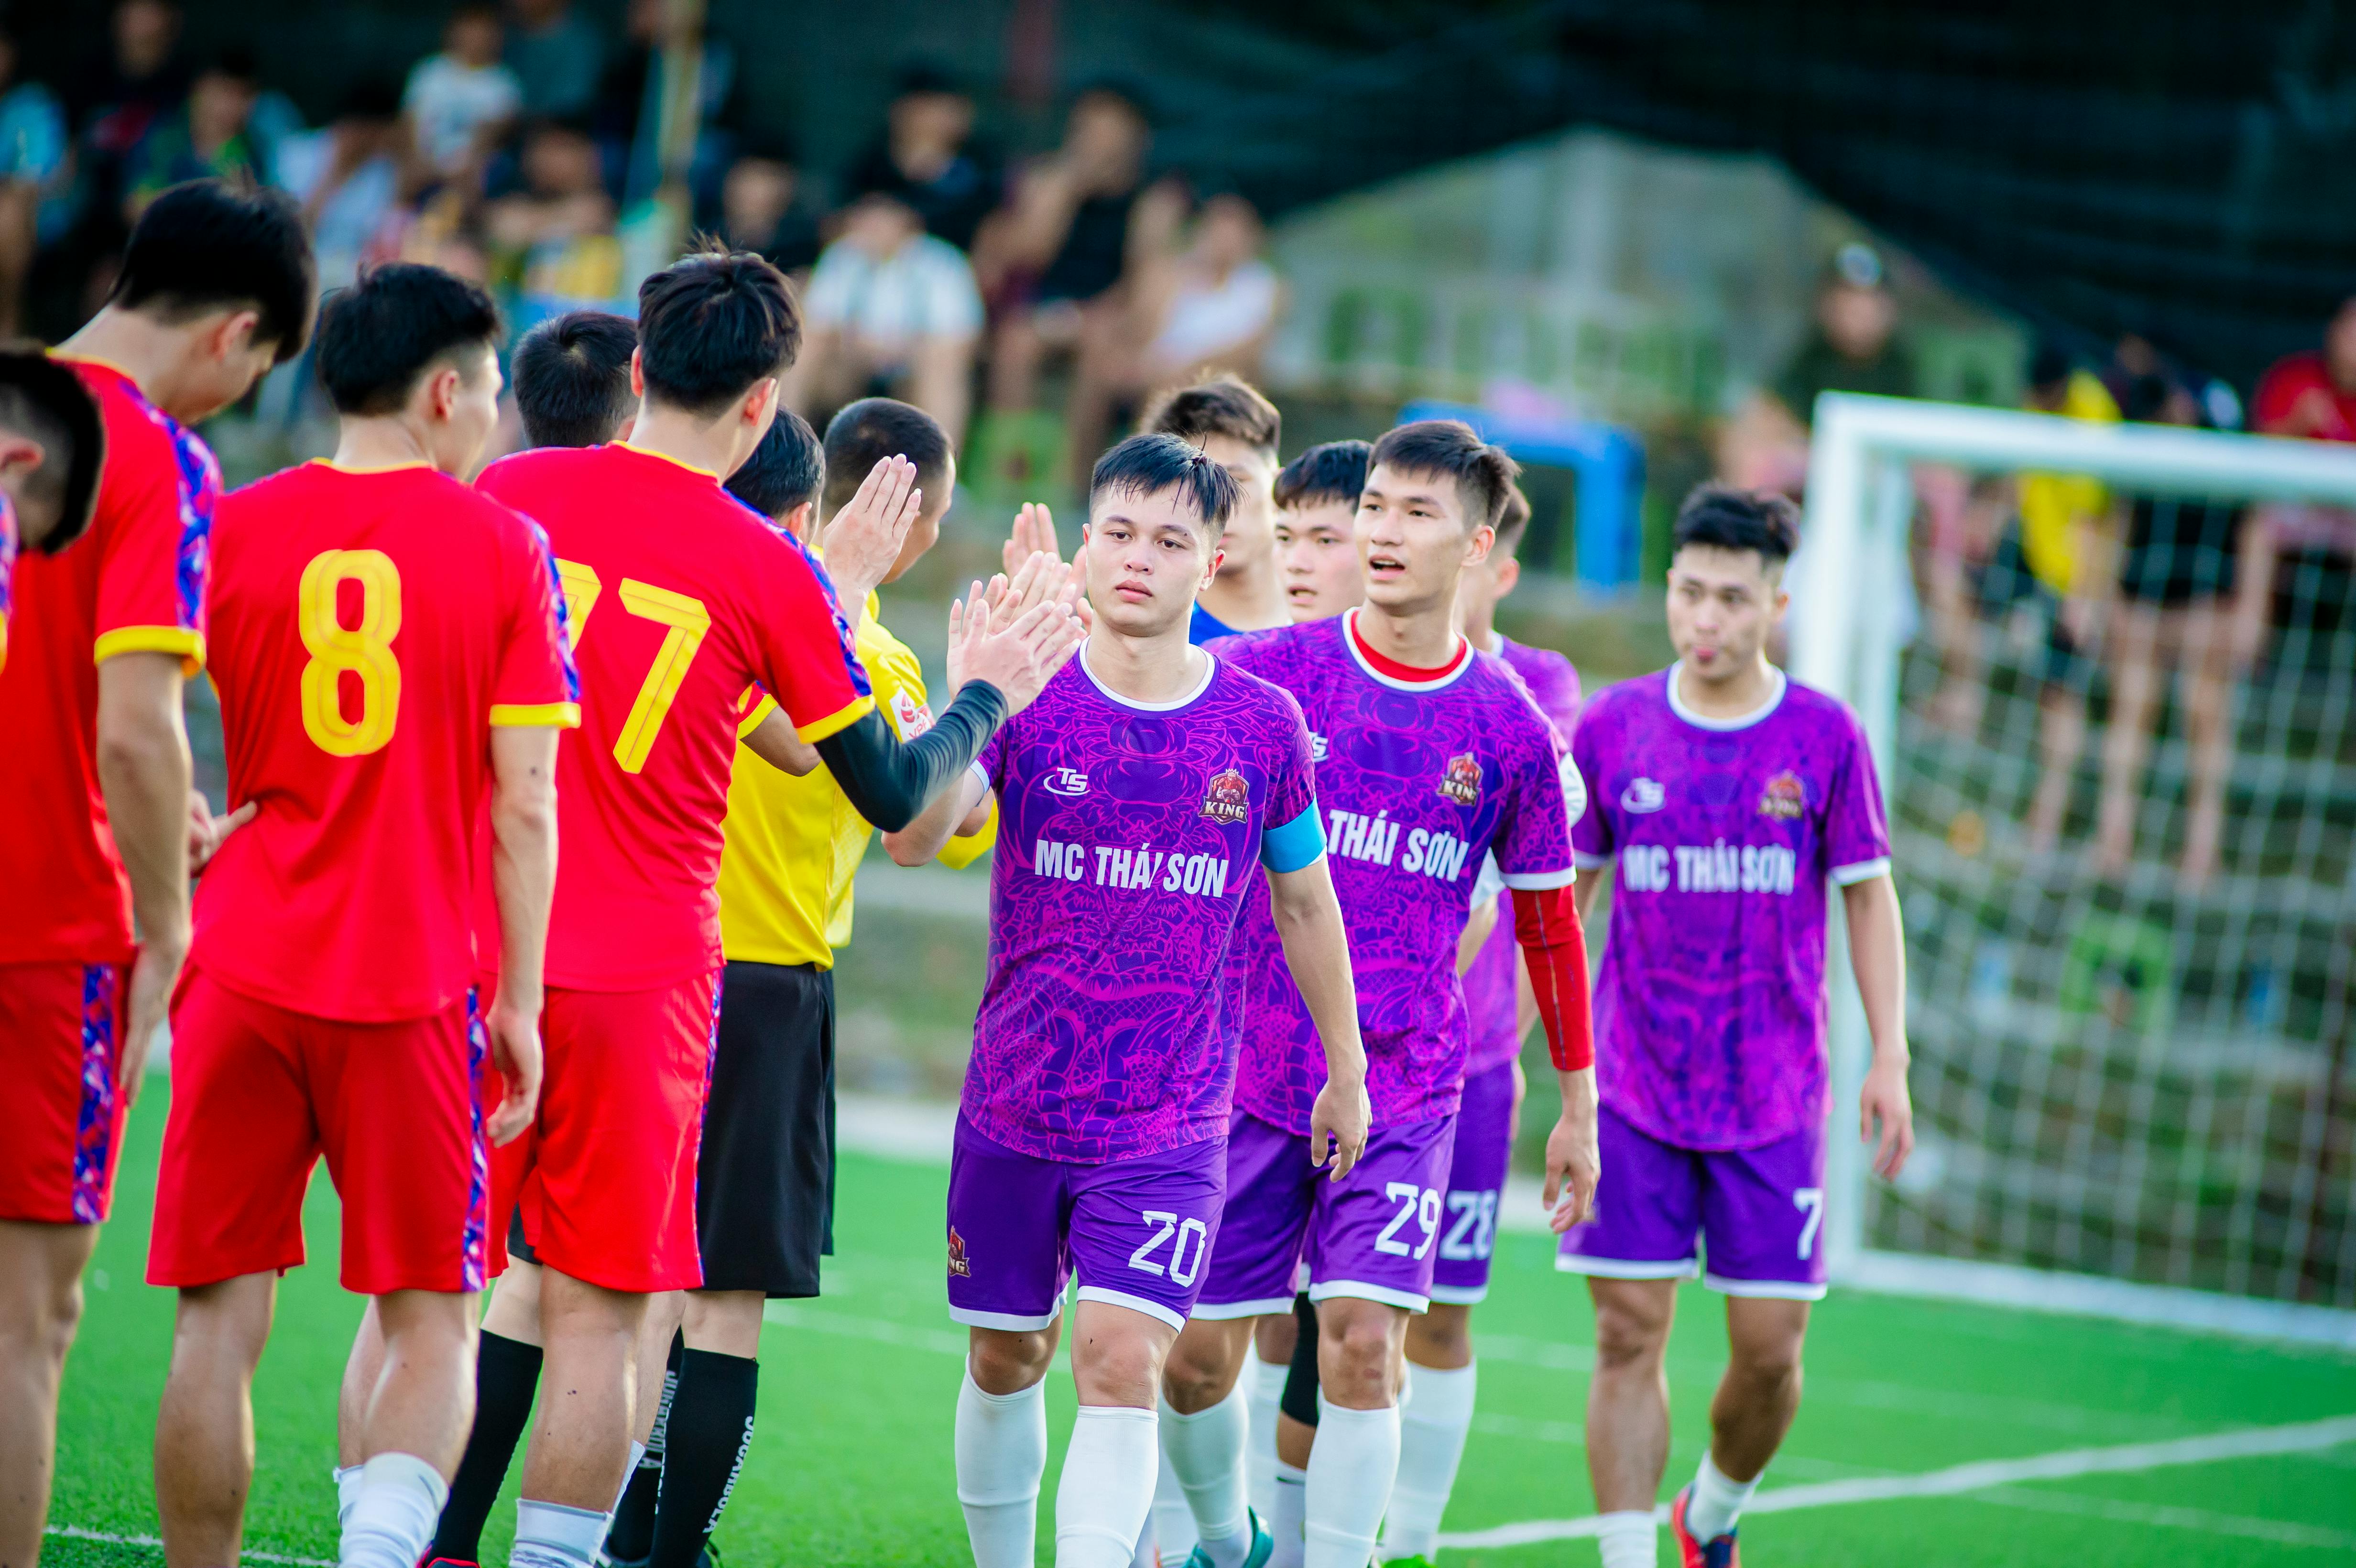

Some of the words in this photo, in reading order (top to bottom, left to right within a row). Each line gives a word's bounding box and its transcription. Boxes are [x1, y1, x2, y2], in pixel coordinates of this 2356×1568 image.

[298, 549, 402, 757] 8
[1057, 767, 1088, 792] TS
[1204, 801, 1245, 819] KING
[1443, 780, 1476, 801] KIN
[1035, 839, 1084, 882] MC
[1095, 842, 1164, 890] THÁI
[1163, 852, 1229, 898] SƠN
[1326, 810, 1400, 866] THÁI
[1401, 827, 1469, 882] SƠN
[1623, 844, 1670, 893] MC
[1674, 837, 1740, 893] THÁI
[1128, 1210, 1207, 1288] 20
[1374, 1181, 1441, 1261] 29
[1439, 1189, 1497, 1261] 28
[1793, 1187, 1823, 1260] 7
